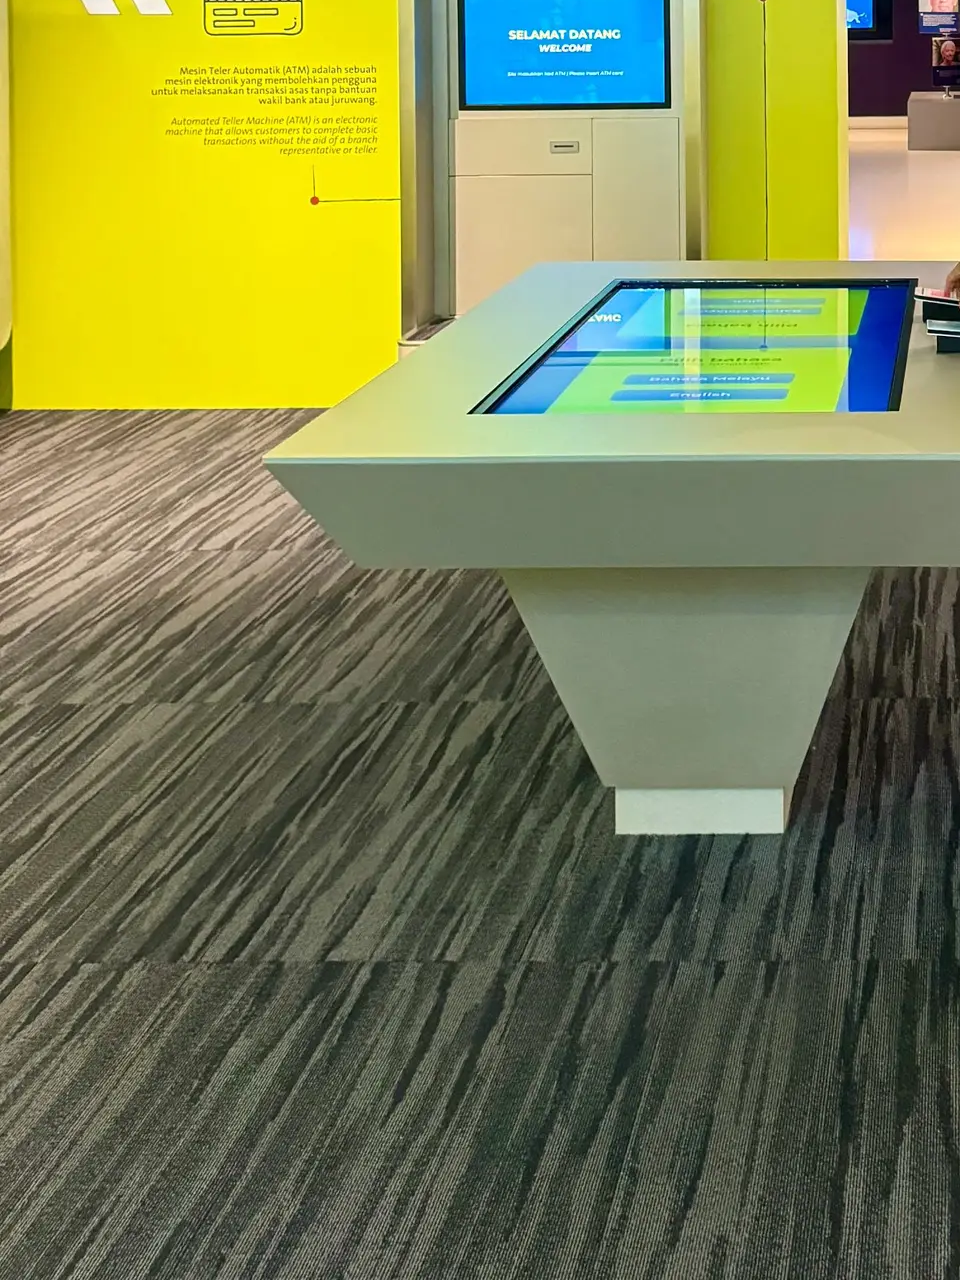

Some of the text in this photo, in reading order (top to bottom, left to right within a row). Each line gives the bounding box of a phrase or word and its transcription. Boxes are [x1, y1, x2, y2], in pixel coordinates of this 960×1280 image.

[508, 29, 621, 41] SELAMAT DATANG
[539, 43, 593, 53] WELCOME
[179, 65, 377, 75] Mesin Teler Automatik (ATM) adalah sebuah
[165, 76, 377, 86] mesin elektronik yang membolehkan pengguna
[151, 85, 377, 96] untuk melaksanakan transaksi asas tanpa bantuan
[258, 96, 283, 105] wakil
[285, 96, 307, 104] bank
[170, 117, 220, 126] Automated
[222, 116, 244, 125] Teller
[246, 116, 284, 125] Machine
[286, 116, 311, 126] (ATM)
[313, 116, 320, 124] is
[335, 115, 378, 124] electronic
[165, 125, 378, 136] machine that allows customers to complete basic
[203, 136, 257, 146] transactions
[259, 136, 294, 145] without
[296, 136, 311, 144] the
[312, 136, 327, 144] aid
[328, 135, 339, 146] of
[347, 135, 378, 144] branch
[279, 146, 341, 156] representative
